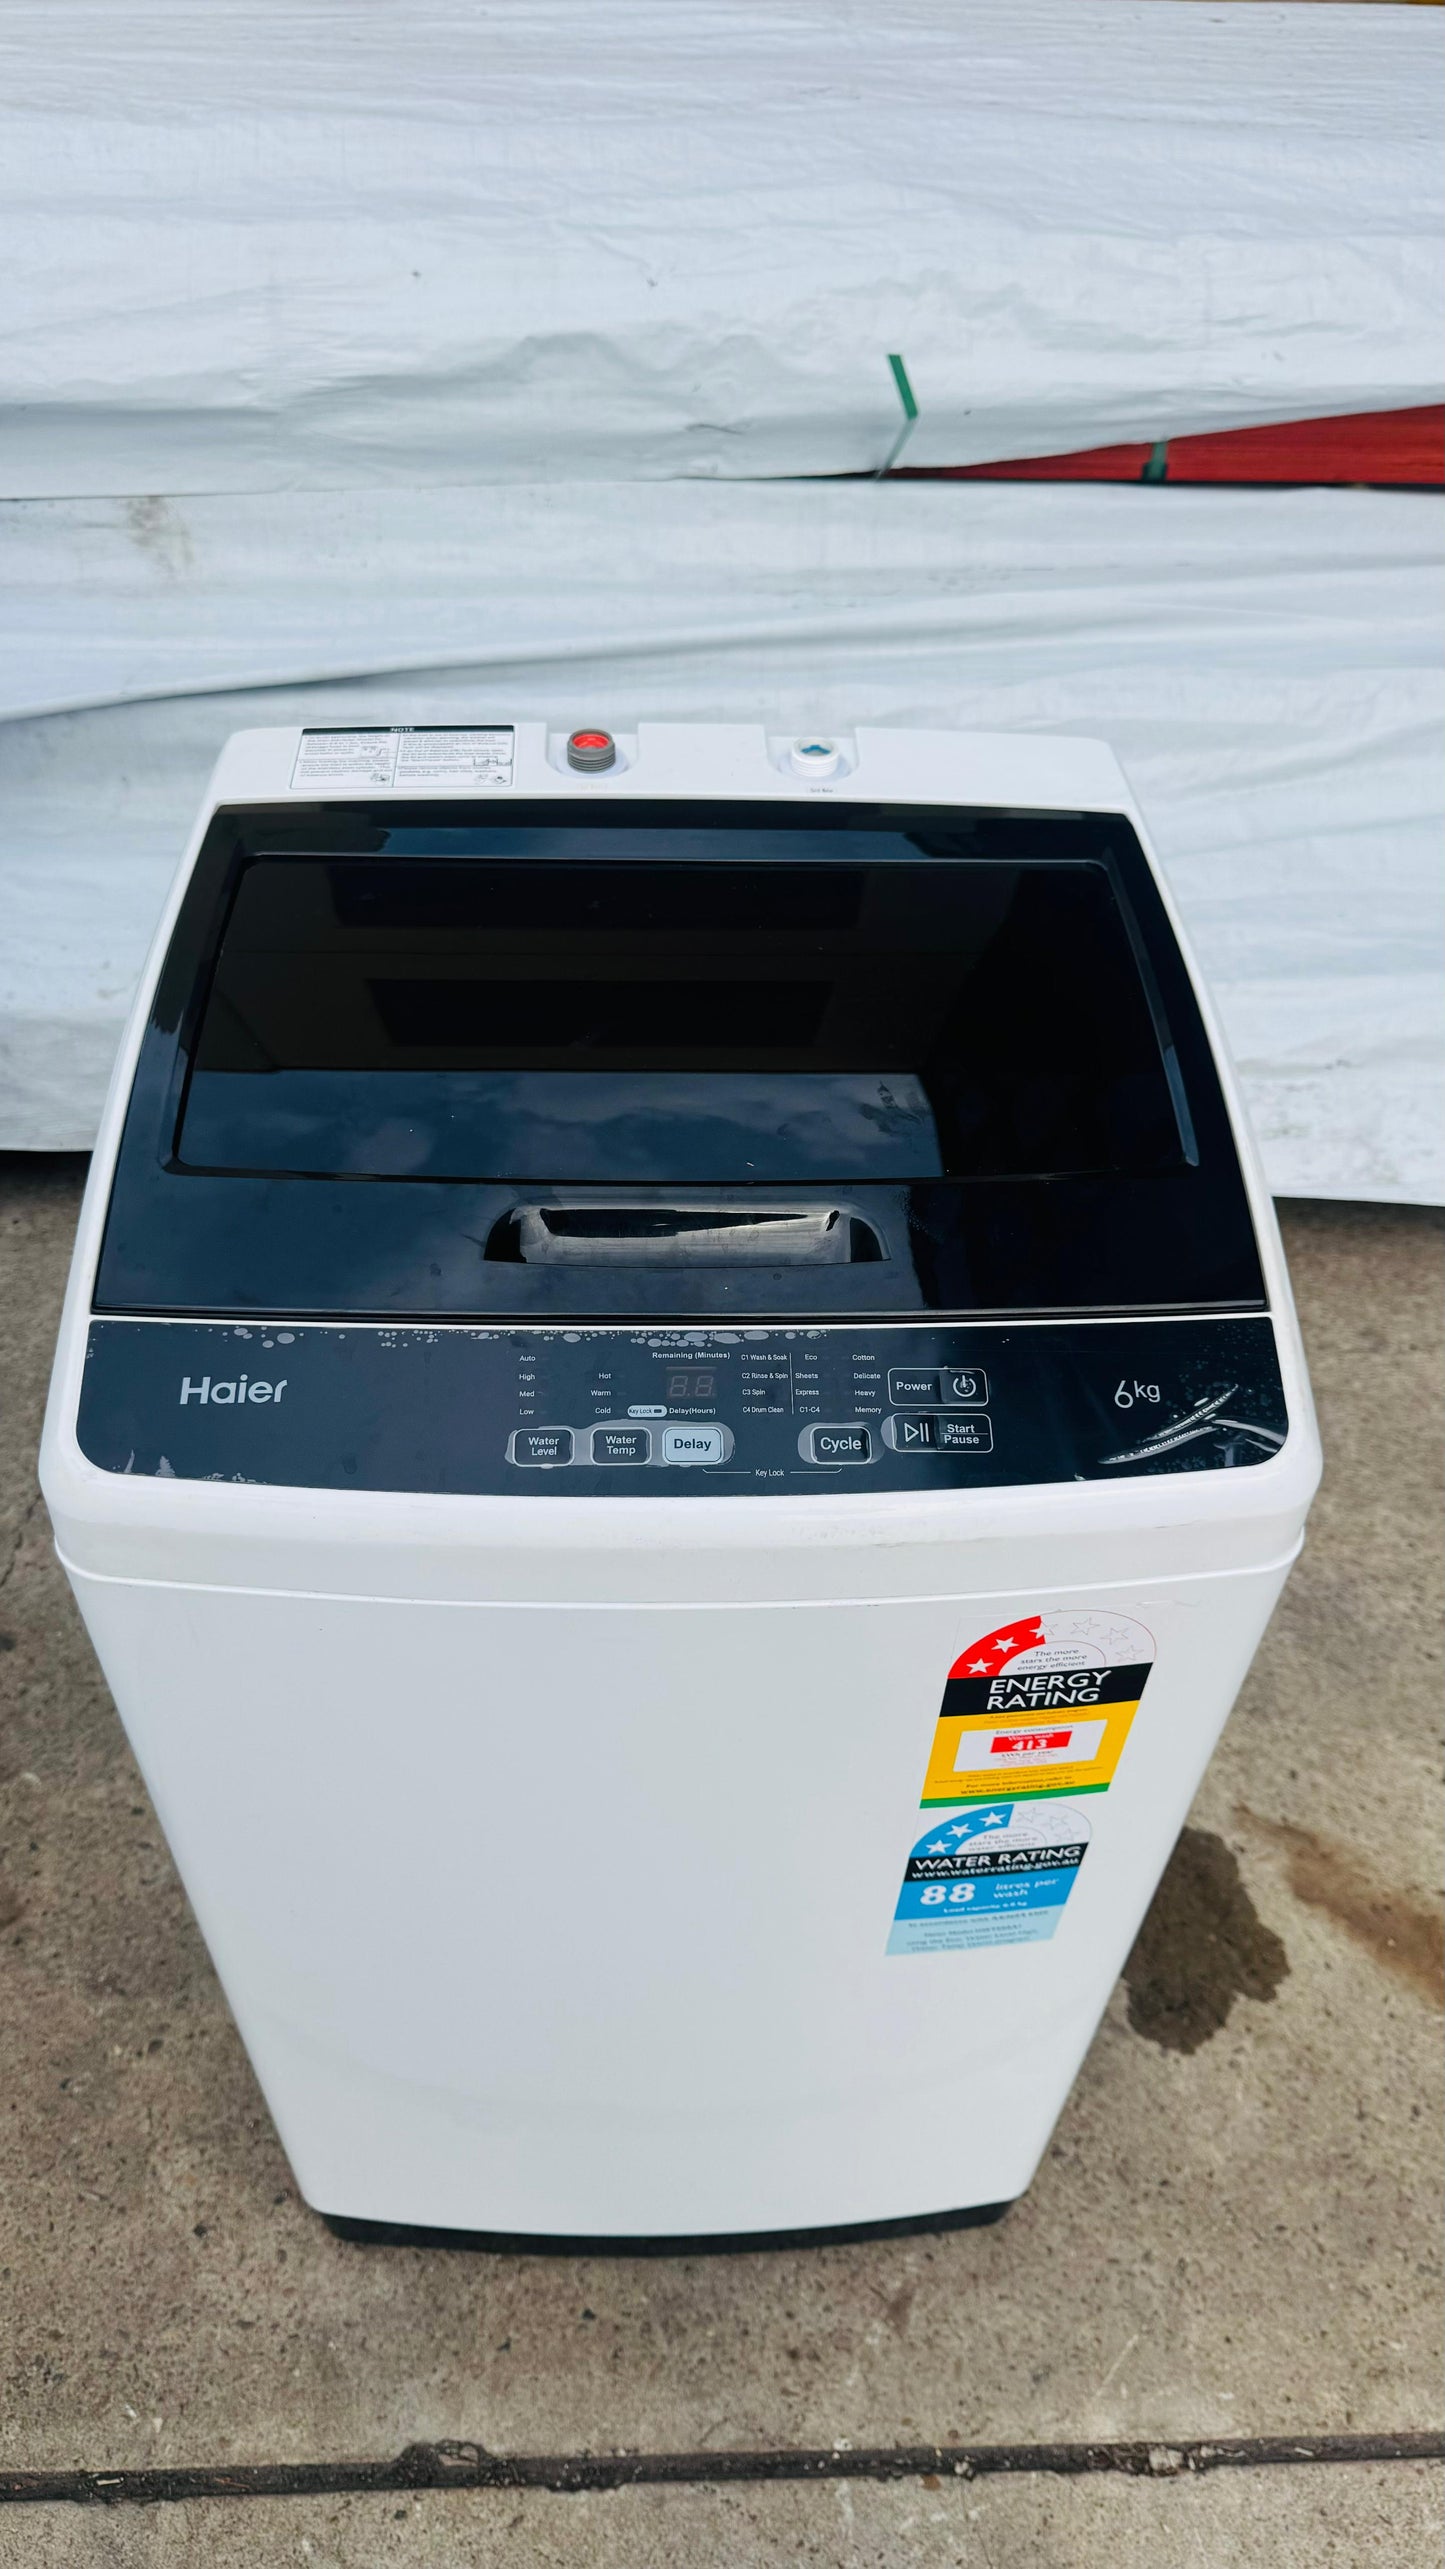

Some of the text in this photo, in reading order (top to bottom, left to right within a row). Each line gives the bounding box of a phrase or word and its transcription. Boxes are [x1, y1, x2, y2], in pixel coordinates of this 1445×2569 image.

[519, 1354, 536, 1362] Auto
[652, 1352, 692, 1360] Remaining
[519, 1373, 535, 1381] High
[180, 1374, 287, 1404] Haier
[896, 1381, 932, 1391] Power
[947, 1424, 975, 1433] Start
[528, 1437, 559, 1446] Water
[605, 1435, 636, 1445] Water
[944, 1434, 979, 1444] Pause
[674, 1438, 712, 1451] Delay
[820, 1437, 862, 1453] Cycle
[532, 1446, 557, 1456] Level
[607, 1446, 636, 1456] Temp
[755, 1469, 766, 1477] Key
[990, 1670, 1112, 1694] ENERGY
[987, 1688, 1101, 1710] RATING
[1012, 1740, 1048, 1750] 413
[915, 1846, 1081, 1870] WATER RATING
[1034, 1879, 1060, 1888] per
[920, 1883, 976, 1905] 88
[993, 1889, 1028, 1898] wash
